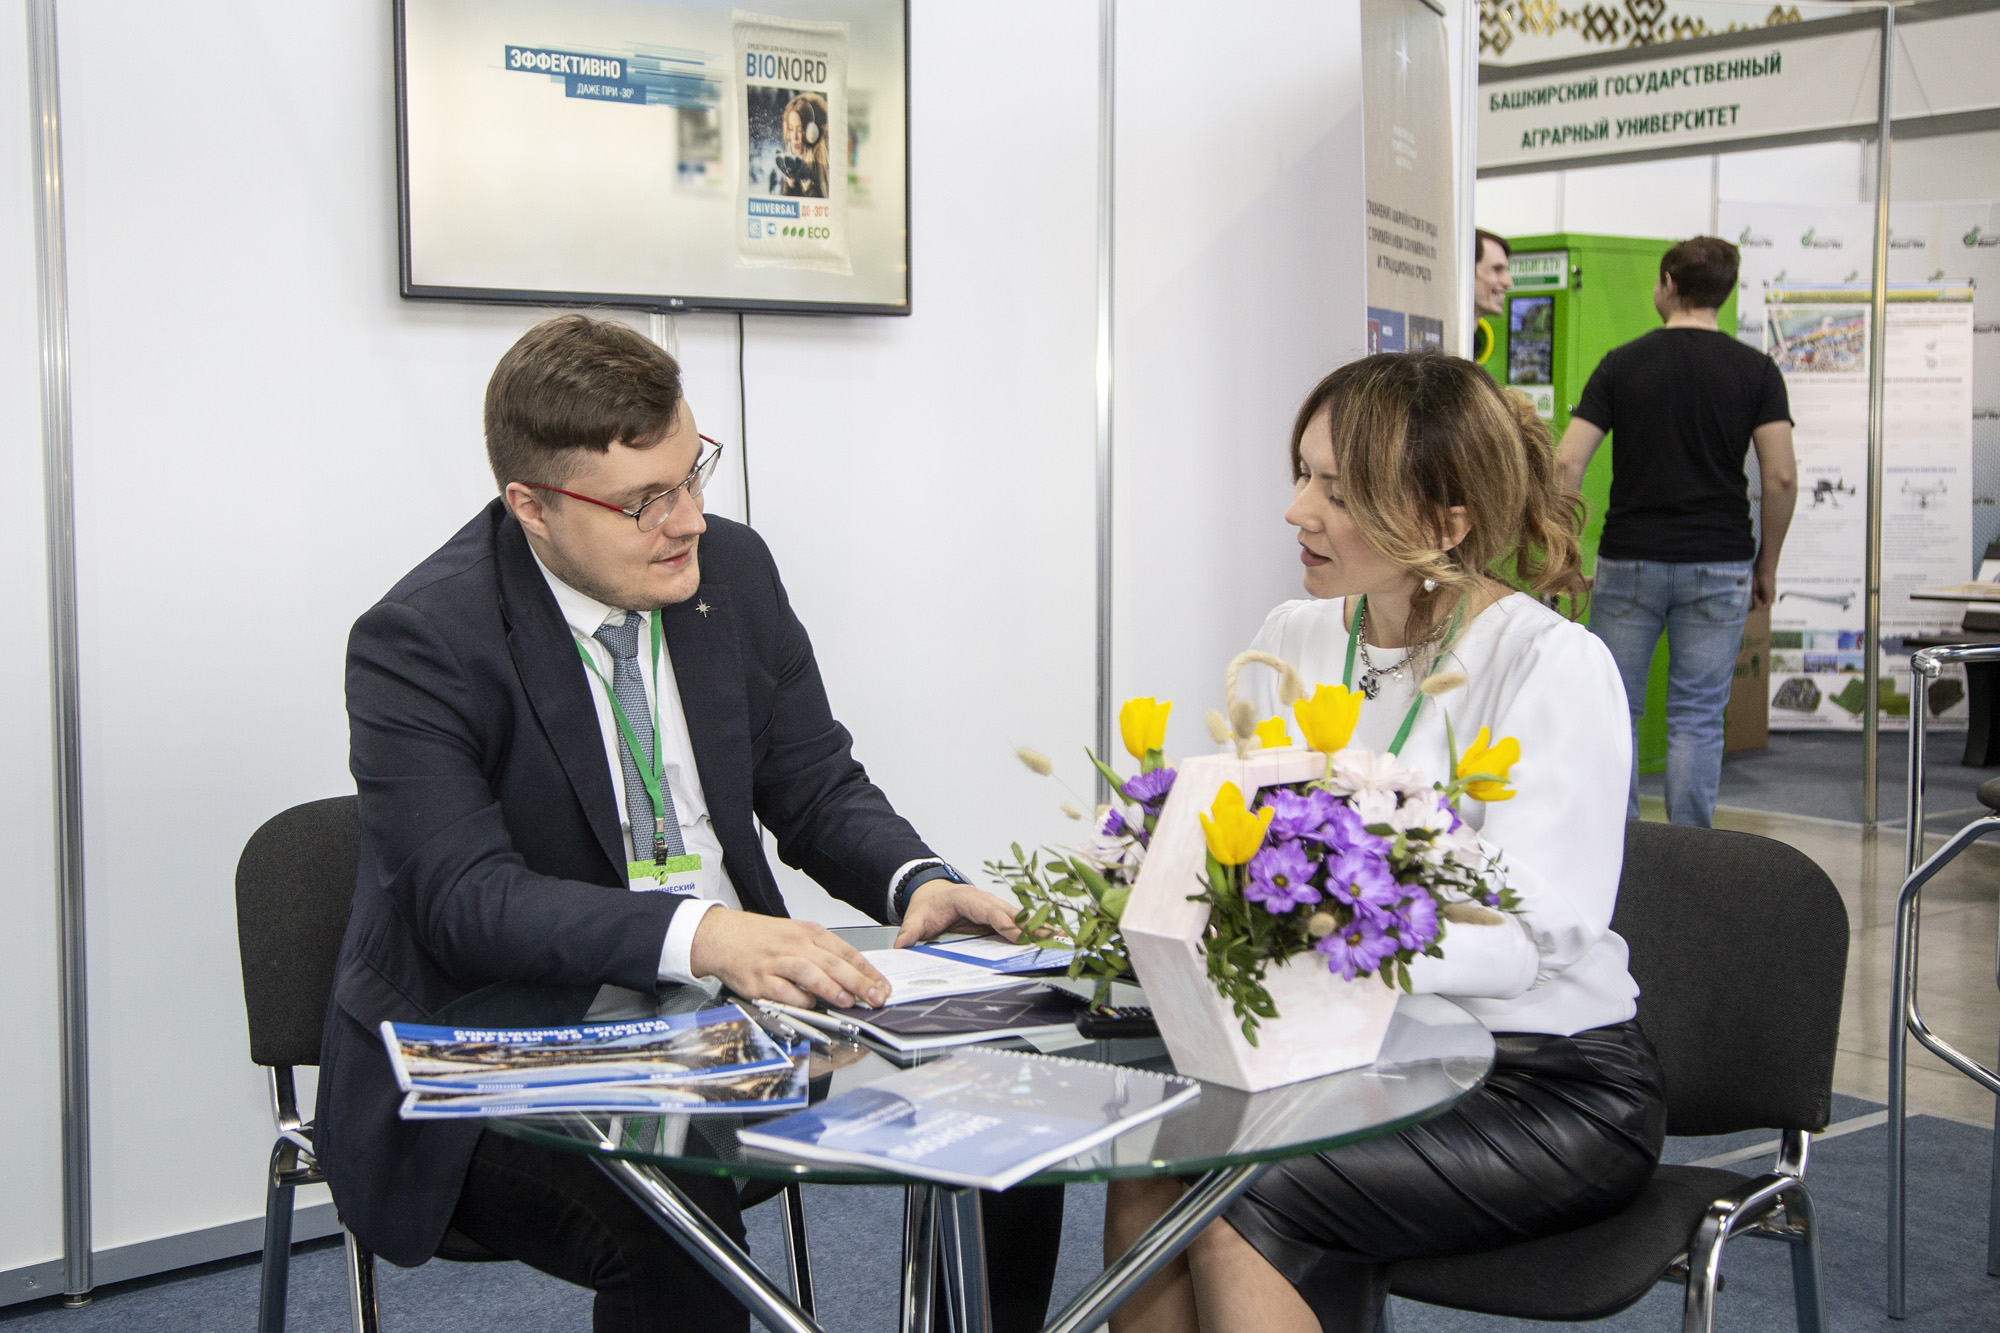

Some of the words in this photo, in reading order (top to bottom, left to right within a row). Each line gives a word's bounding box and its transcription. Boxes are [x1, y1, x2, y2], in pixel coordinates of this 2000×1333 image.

[510, 48, 621, 79] ЭФФЕКТИВНО
[746, 53, 827, 84] BIONORD
[577, 83, 600, 95] ДАЖЕ
[602, 86, 618, 97] ПРИ
[1490, 77, 1598, 112] БАШКИРСКИЙ
[1605, 50, 1782, 96] ГОСУДАРСТВЕННЫЙ
[1521, 116, 1609, 149] АГРАРНЫЙ
[1616, 104, 1740, 139] УНИВЕРСИТЕТ
[750, 201, 796, 216] UNIVERSAL
[808, 226, 829, 239] ECO
